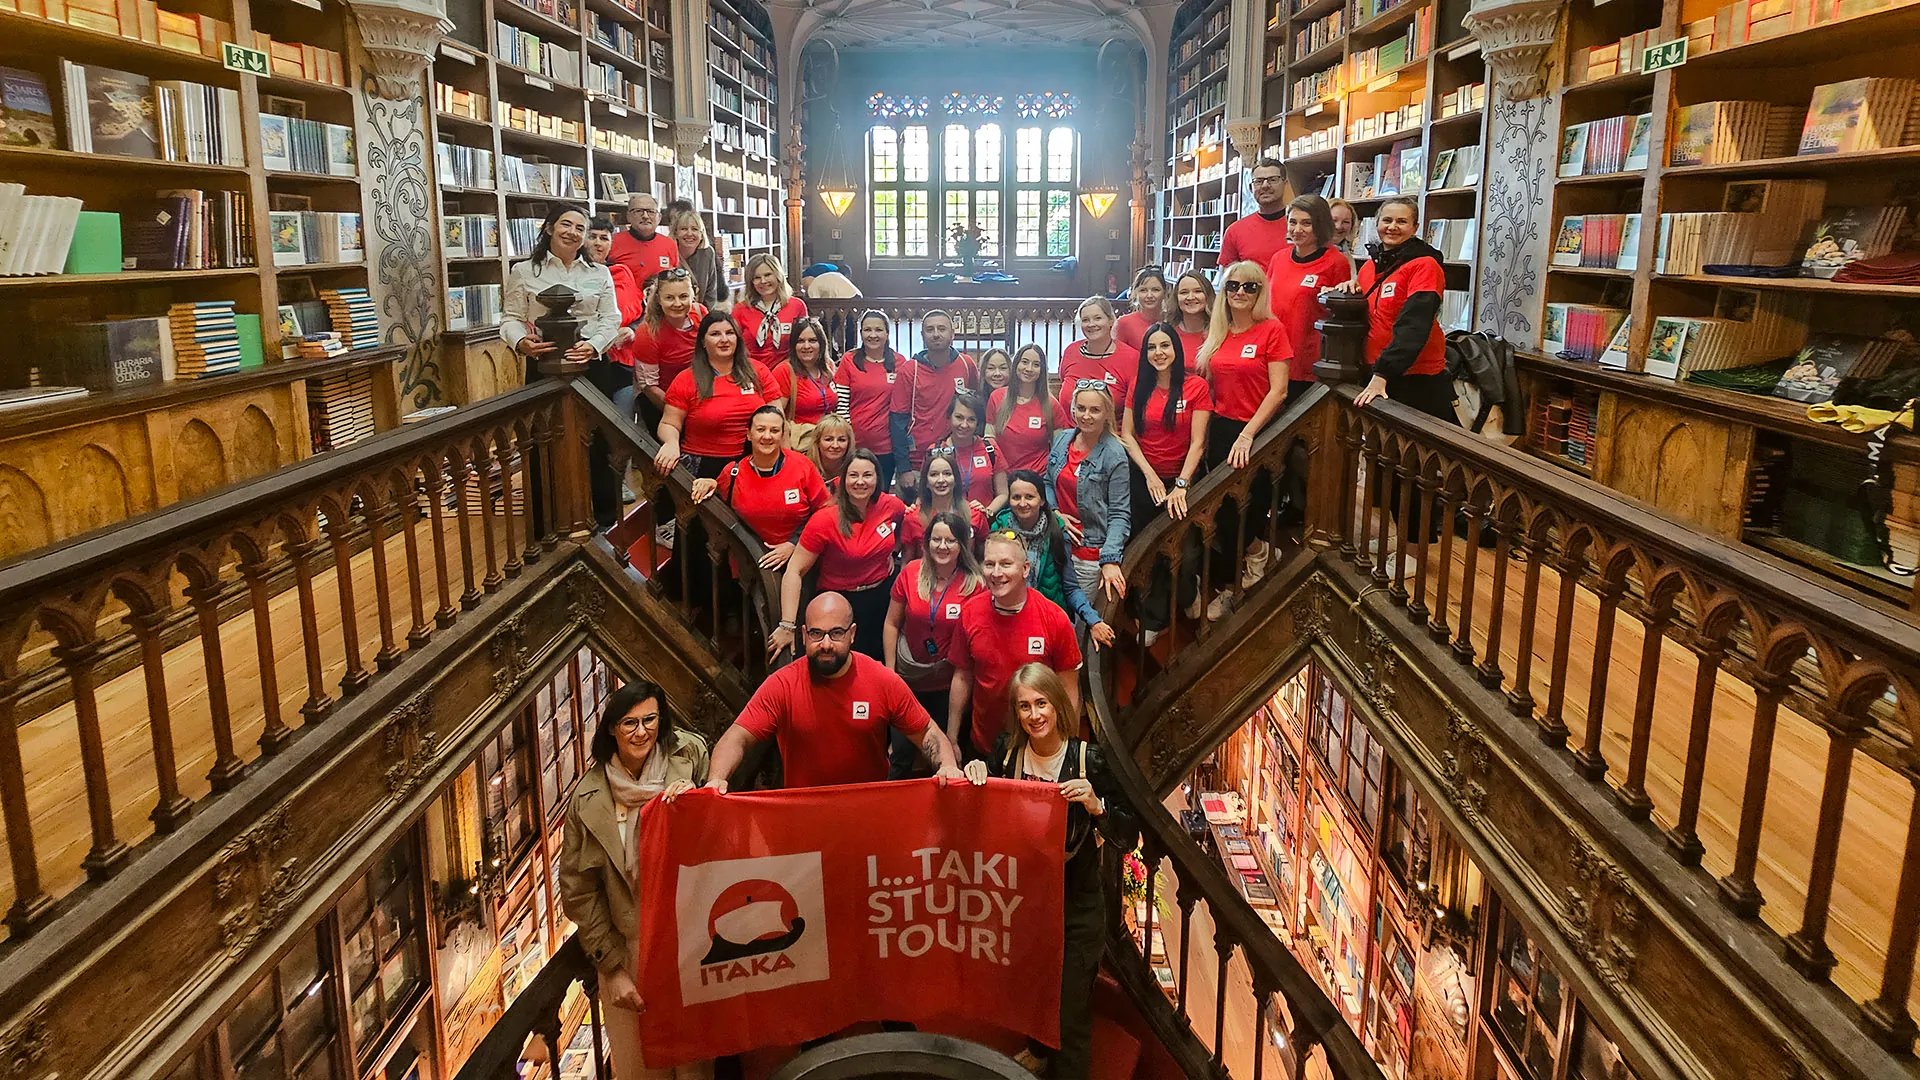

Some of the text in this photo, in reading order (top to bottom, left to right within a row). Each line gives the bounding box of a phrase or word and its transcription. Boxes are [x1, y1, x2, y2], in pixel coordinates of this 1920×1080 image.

[114, 357, 153, 369] LIVRARIA
[867, 847, 1018, 890] I...TAKI
[868, 884, 1024, 928] STUDY
[868, 918, 1011, 967] TOUR!
[700, 952, 796, 987] ITAKA
